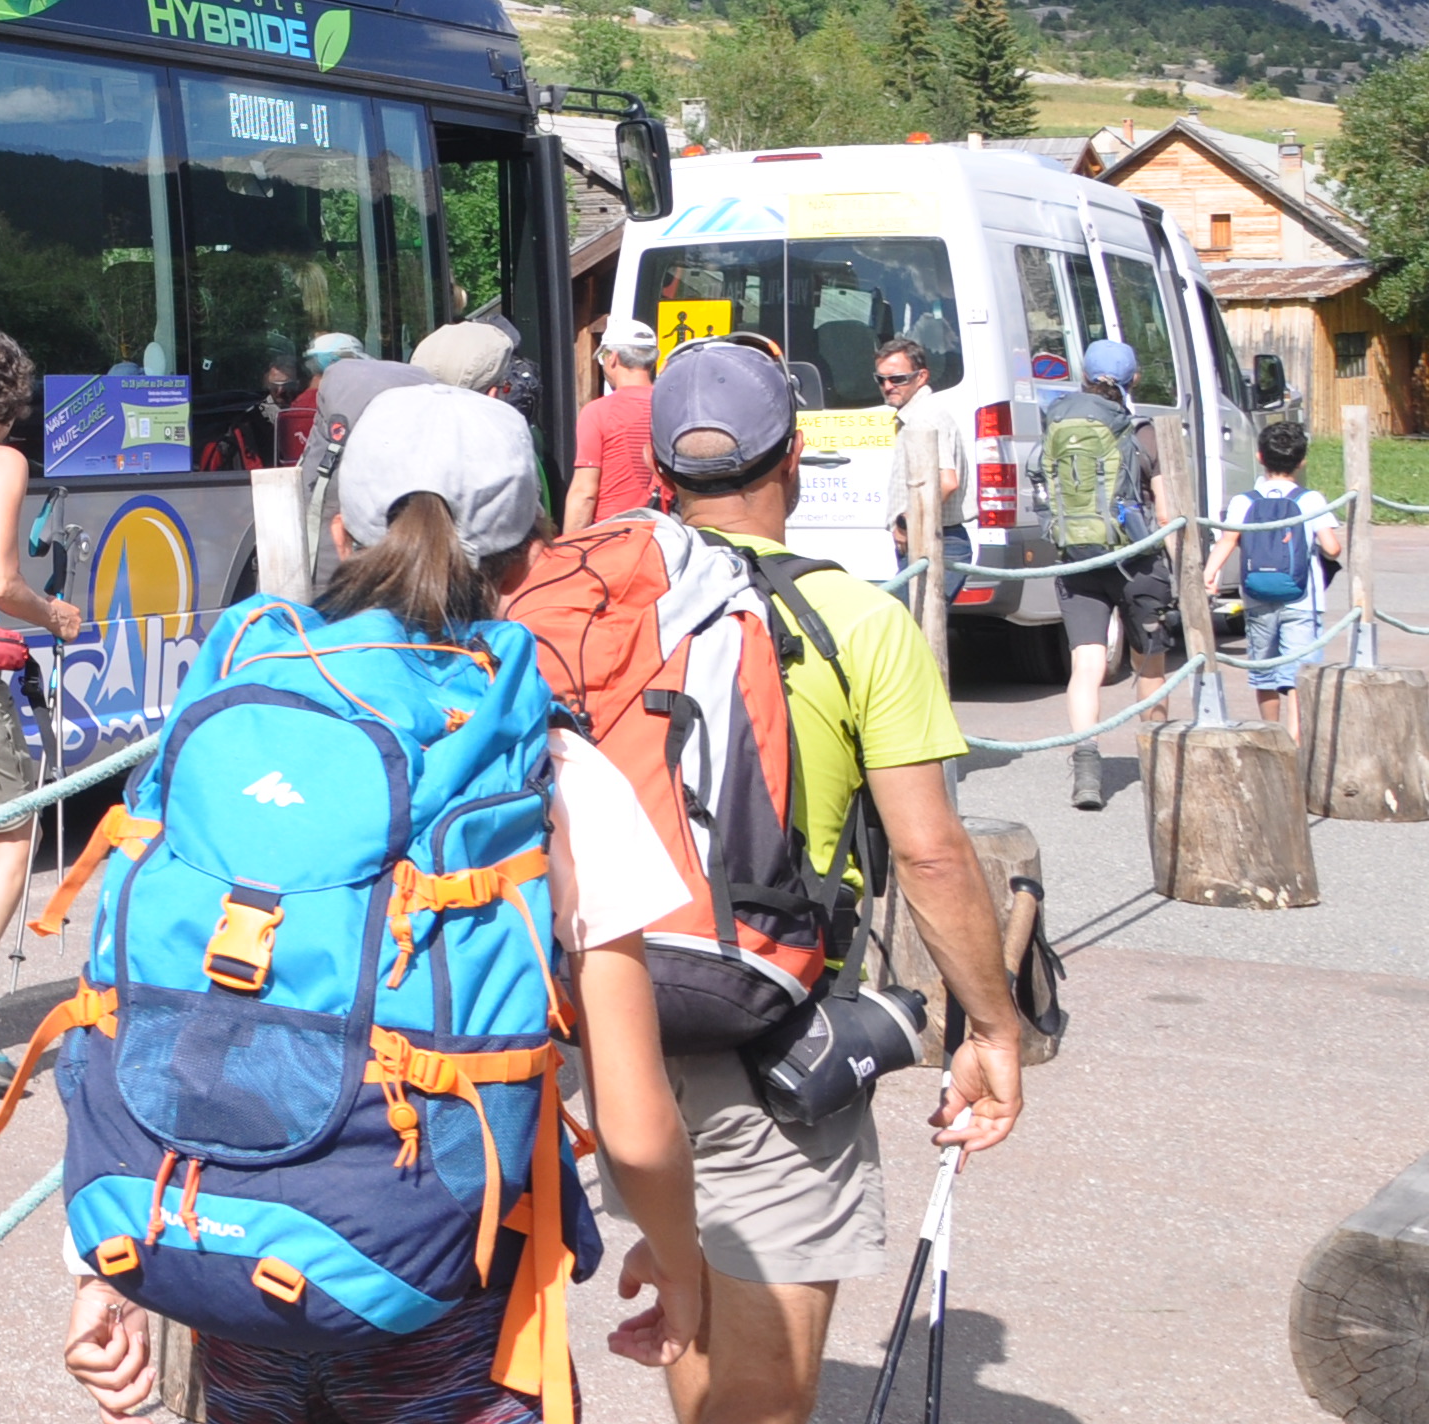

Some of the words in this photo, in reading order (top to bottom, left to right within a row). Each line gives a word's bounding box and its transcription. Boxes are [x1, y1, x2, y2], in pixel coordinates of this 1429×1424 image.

[229, 92, 297, 145] ROUBION
[46, 397, 84, 436] NAVETTES
[84, 389, 94, 406] DE
[94, 381, 106, 397] LA
[797, 416, 856, 428] AVETTES
[859, 416, 875, 427] DE
[803, 436, 837, 448] AUTE
[801, 494, 816, 503] ax
[821, 492, 838, 503] 04
[843, 492, 859, 503] 92
[865, 492, 881, 503] 45
